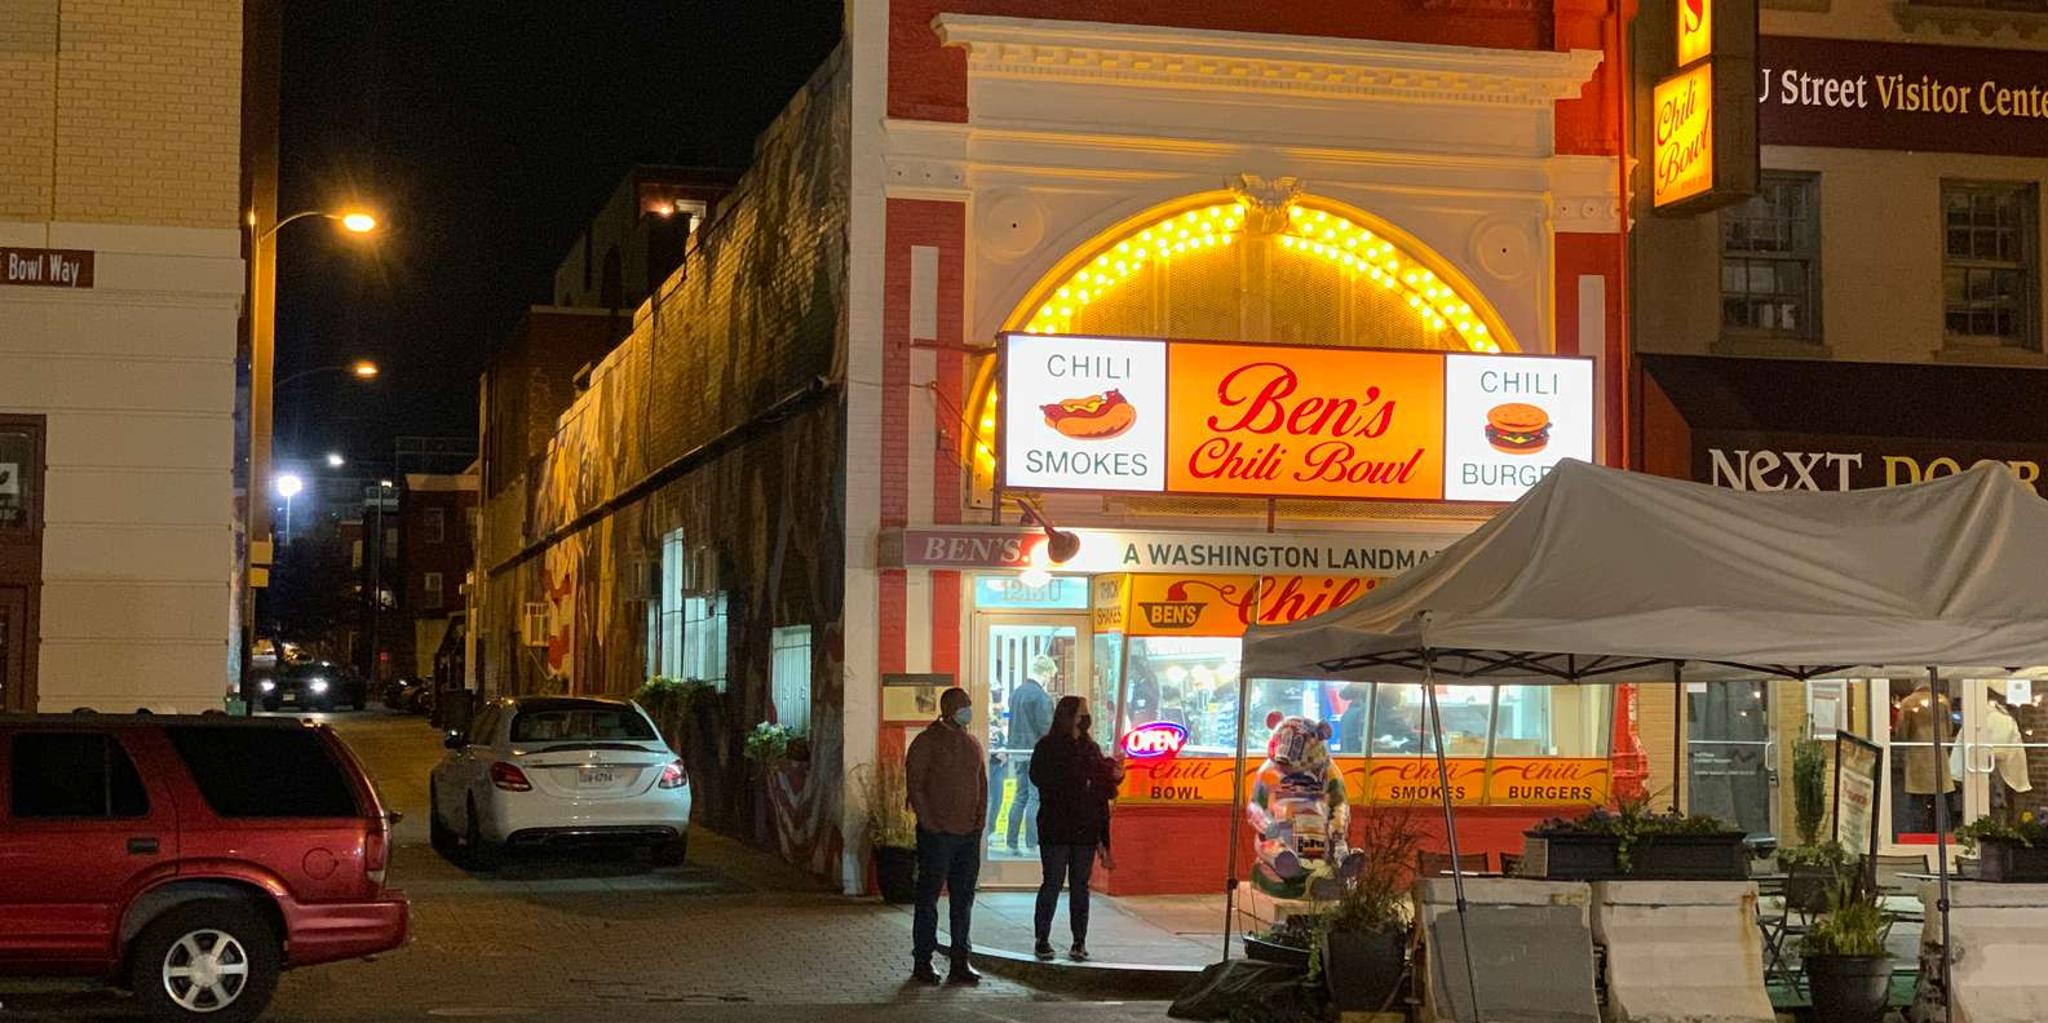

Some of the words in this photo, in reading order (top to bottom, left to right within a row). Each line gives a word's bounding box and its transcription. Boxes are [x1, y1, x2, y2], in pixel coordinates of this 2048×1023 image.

[1781, 70, 1868, 109] Street
[1875, 73, 1972, 114] Visitor
[1657, 78, 1697, 147] Chili
[1656, 108, 1710, 196] Bowl
[8, 252, 43, 281] Bowl
[49, 254, 80, 288] Way
[1047, 354, 1131, 379] CHILI
[1480, 371, 1558, 395] CHILI
[1207, 362, 1396, 438] Ben's
[1026, 449, 1148, 477] SMOKES
[1189, 437, 1287, 481] Chili
[1293, 440, 1425, 485] Bowl
[1123, 543, 1141, 565] A
[1147, 543, 1319, 569] WASHINGTON
[1327, 548, 1441, 570] LANDMA
[1238, 575, 1376, 625] Chil
[1151, 604, 1197, 625] BEN'S
[1127, 730, 1180, 752] OPEN
[1148, 761, 1211, 780] Chili
[1400, 762, 1458, 781] Chii
[1521, 762, 1580, 781] Chili
[1150, 786, 1203, 800] BOWL
[1508, 785, 1593, 800] BURGERS
